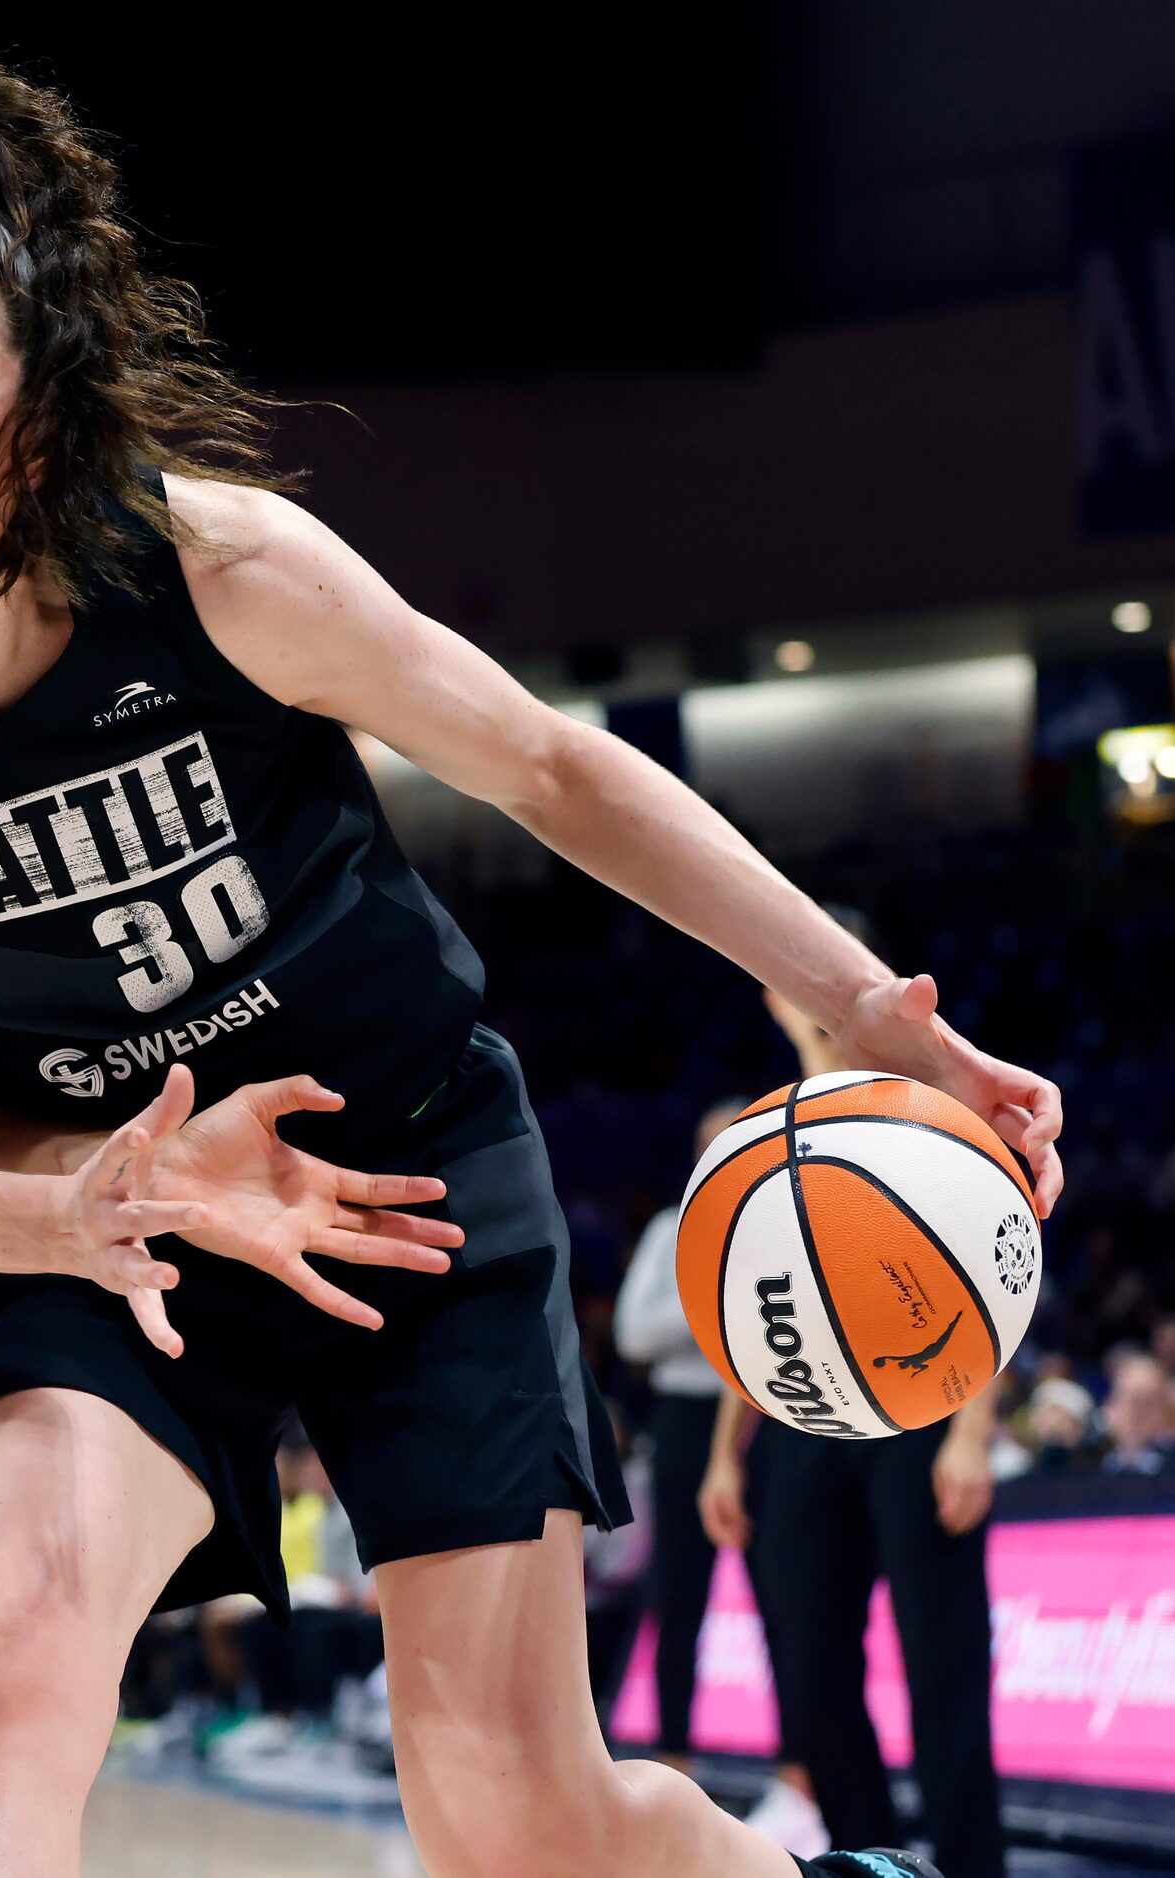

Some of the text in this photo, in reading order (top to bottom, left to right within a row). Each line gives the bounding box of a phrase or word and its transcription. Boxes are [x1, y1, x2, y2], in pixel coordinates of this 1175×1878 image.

[92, 691, 177, 728] SYMETRA
[92, 852, 271, 1014] 30
[103, 977, 281, 1081] SWEDISH
[821, 1361, 850, 1406] EVO NXT
